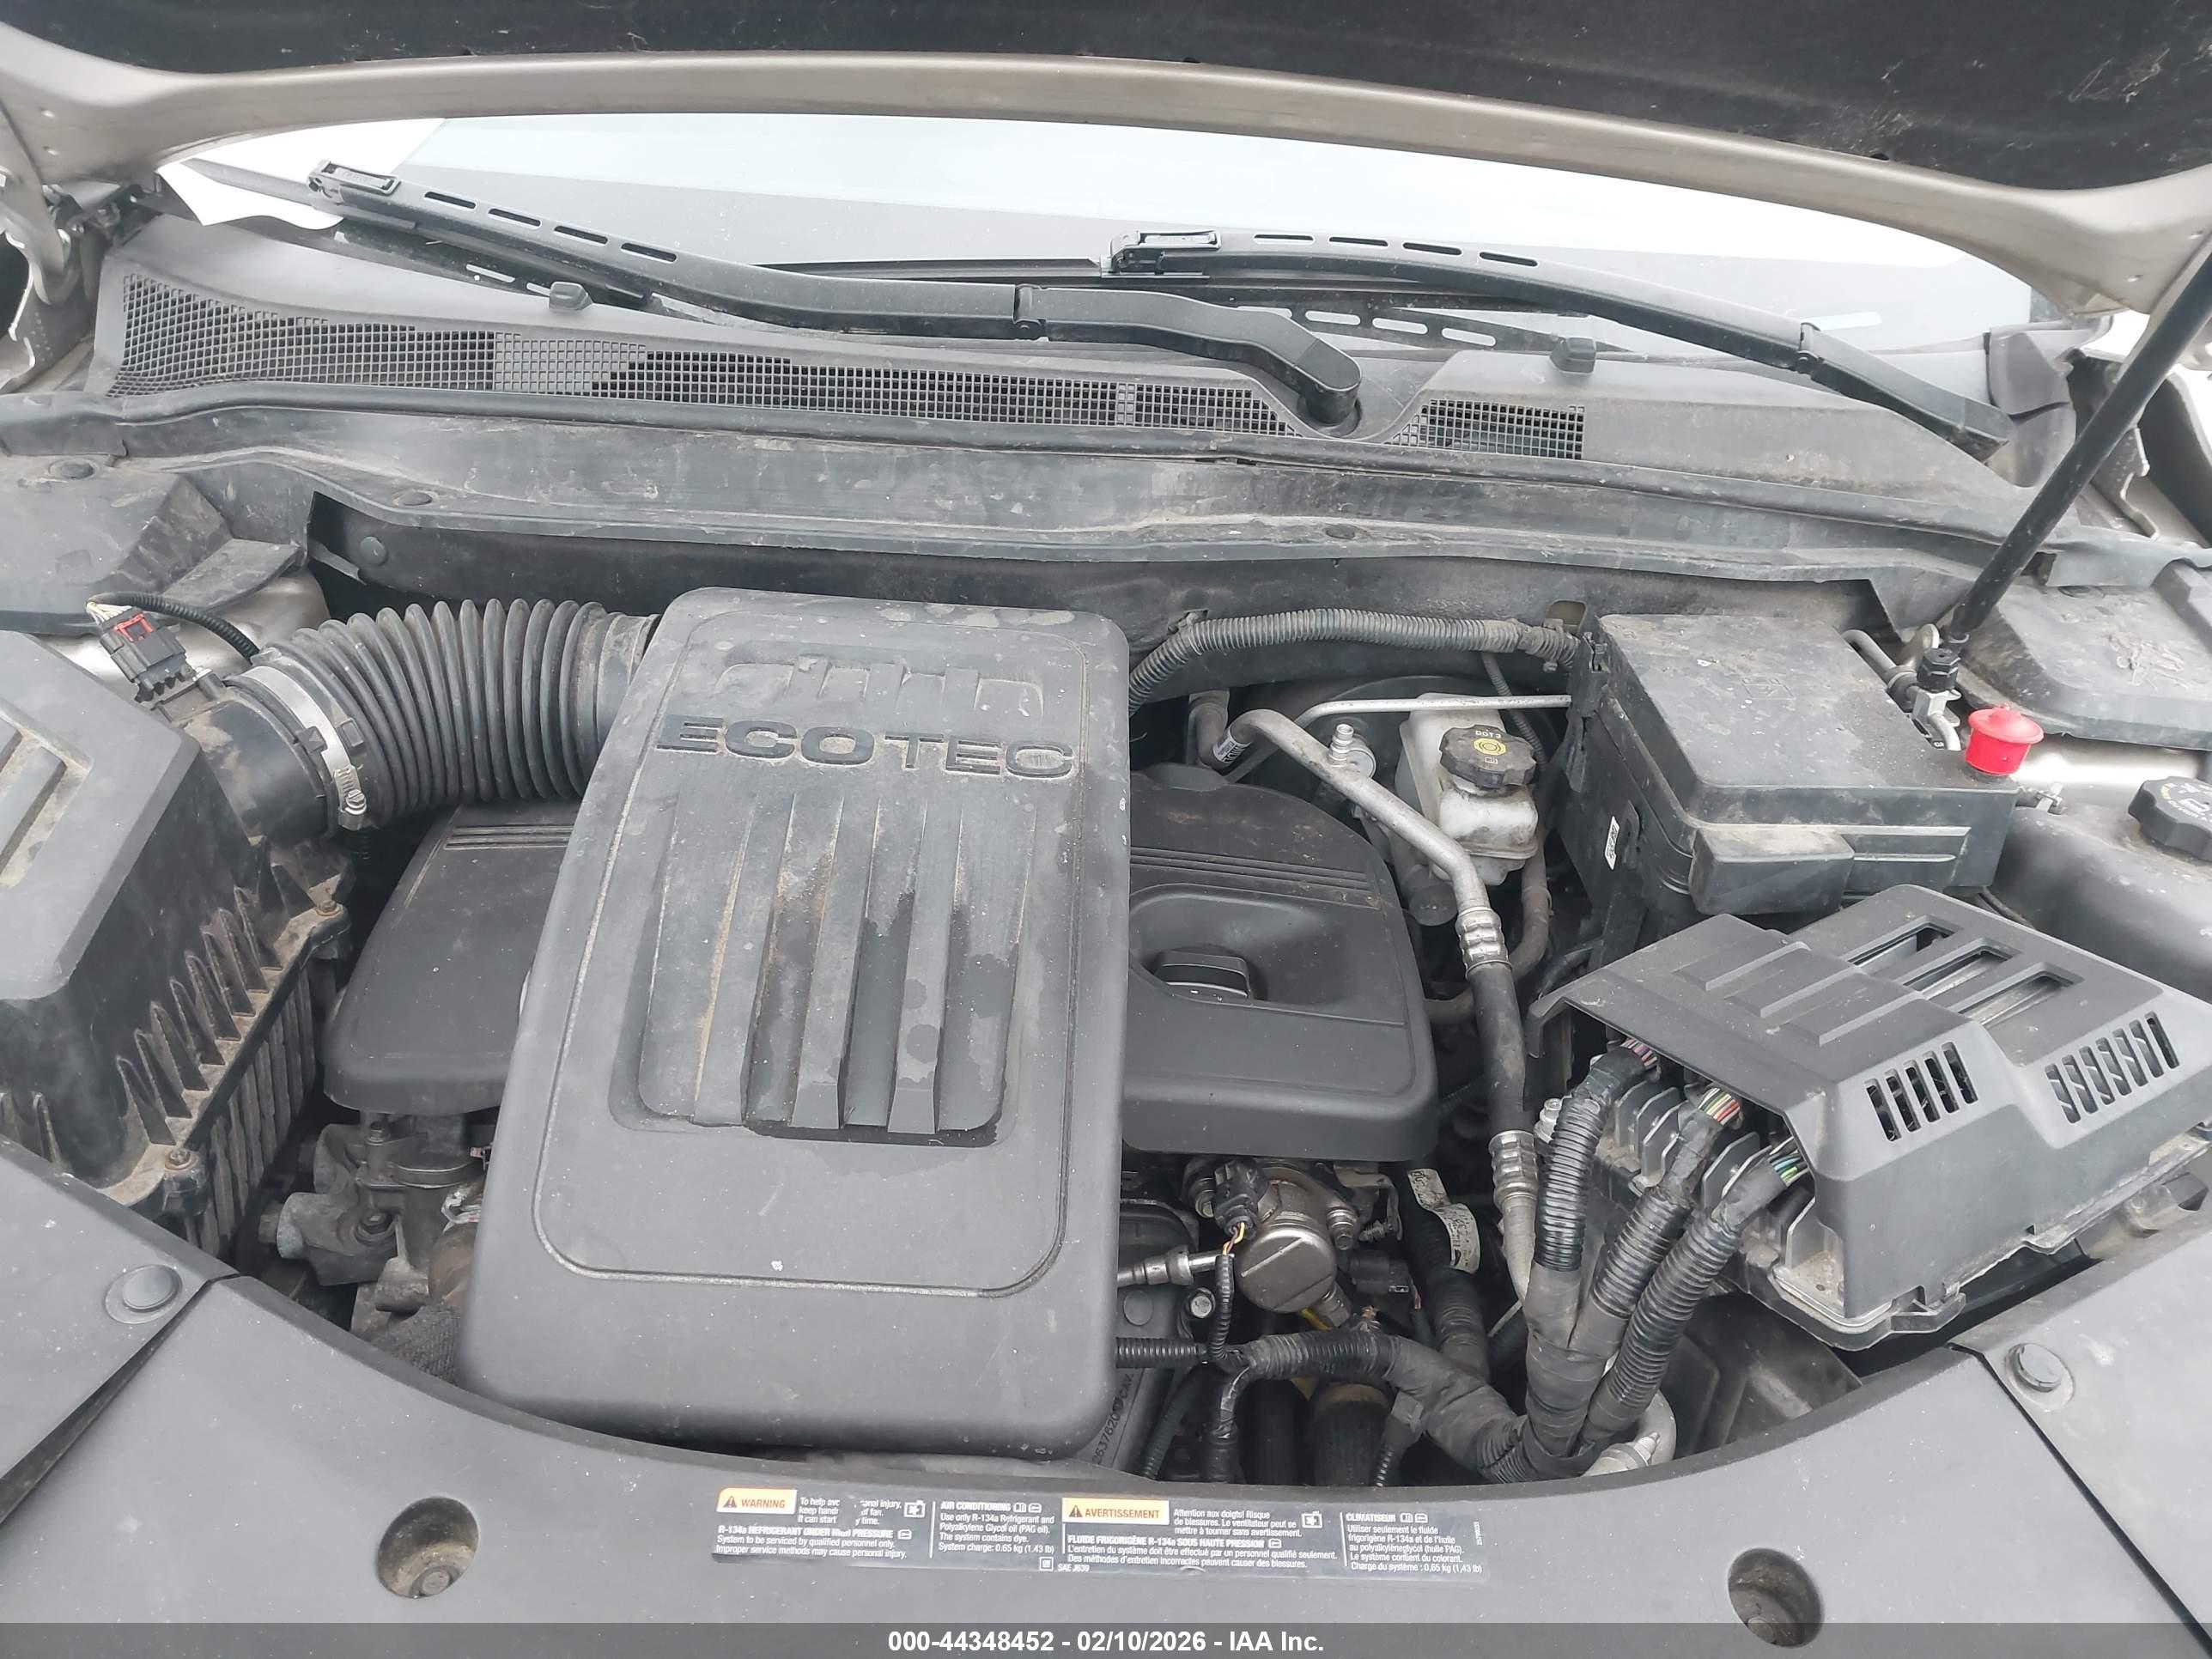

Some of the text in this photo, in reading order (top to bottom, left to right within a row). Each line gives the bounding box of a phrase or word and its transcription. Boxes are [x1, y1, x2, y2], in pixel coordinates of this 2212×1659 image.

[656, 714, 1074, 781] ECOTEC
[742, 1498, 786, 1509] WARNING
[810, 1498, 825, 1506] help
[880, 1500, 902, 1509] injury.
[956, 1502, 1011, 1511] CONDITIONING
[799, 1506, 817, 1515] keep
[1085, 1509, 1159, 1518] AVERTISSEMENT
[1221, 1510, 1244, 1519] doigts!
[1246, 1510, 1270, 1519] Risque
[1000, 1515, 1040, 1524] Refrigerant
[1346, 1513, 1396, 1522] CLIMATISEUR
[718, 1525, 746, 1534] R-134a
[749, 1526, 802, 1535] REFRIGERANT
[804, 1528, 830, 1536] UNDER
[852, 1528, 893, 1538] PRESSURE
[939, 1522, 983, 1532] Polyalkylene
[986, 1524, 1006, 1533] Glycol
[1018, 1525, 1036, 1534] (PAG
[1037, 1525, 1050, 1534] oil).
[1347, 1524, 1371, 1533] Utiliser
[1419, 1526, 1438, 1534] fluide
[717, 1534, 744, 1544] System
[809, 1538, 840, 1547] qualified
[878, 1540, 896, 1549] only.
[955, 1534, 980, 1542] system
[1067, 1534, 1095, 1544] FLUIDE
[1097, 1534, 1147, 1546] FRIGORIGÈNE
[1177, 1538, 1198, 1547] SOUS
[1348, 1534, 1386, 1543] frigorigène
[1388, 1534, 1414, 1543] R-134a
[1435, 1535, 1455, 1544] l'huile
[716, 1545, 749, 1554] Improper
[885, 1551, 907, 1559] injury.
[939, 1542, 965, 1552] System
[967, 1543, 994, 1553] charge:
[1014, 1544, 1023, 1553] kg
[1024, 1545, 1043, 1553] (1.43
[1044, 1546, 1054, 1554] lb)
[1068, 1545, 1105, 1553] L'entretien
[1118, 1547, 1147, 1555] système
[1165, 1547, 1178, 1555] être
[1180, 1548, 1208, 1557] effectué
[1271, 1550, 1297, 1559] qualifié
[1360, 1544, 1423, 1553] polyalkylèneglycol
[1425, 1544, 1443, 1553] (huile
[1445, 1546, 1464, 1554] PAG).
[1084, 1554, 1118, 1563] méthodes
[1121, 1556, 1158, 1565] d'entretien
[1201, 1559, 1230, 1567] peuvent
[1272, 1559, 1307, 1568] blessures.
[1432, 1554, 1462, 1563] colorant.
[1352, 1562, 1376, 1571] Charge
[1389, 1564, 1419, 1572] système
[1425, 1564, 1441, 1572] 0,65
[1443, 1564, 1451, 1573] kg
[1452, 1565, 1471, 1573] (1,43
